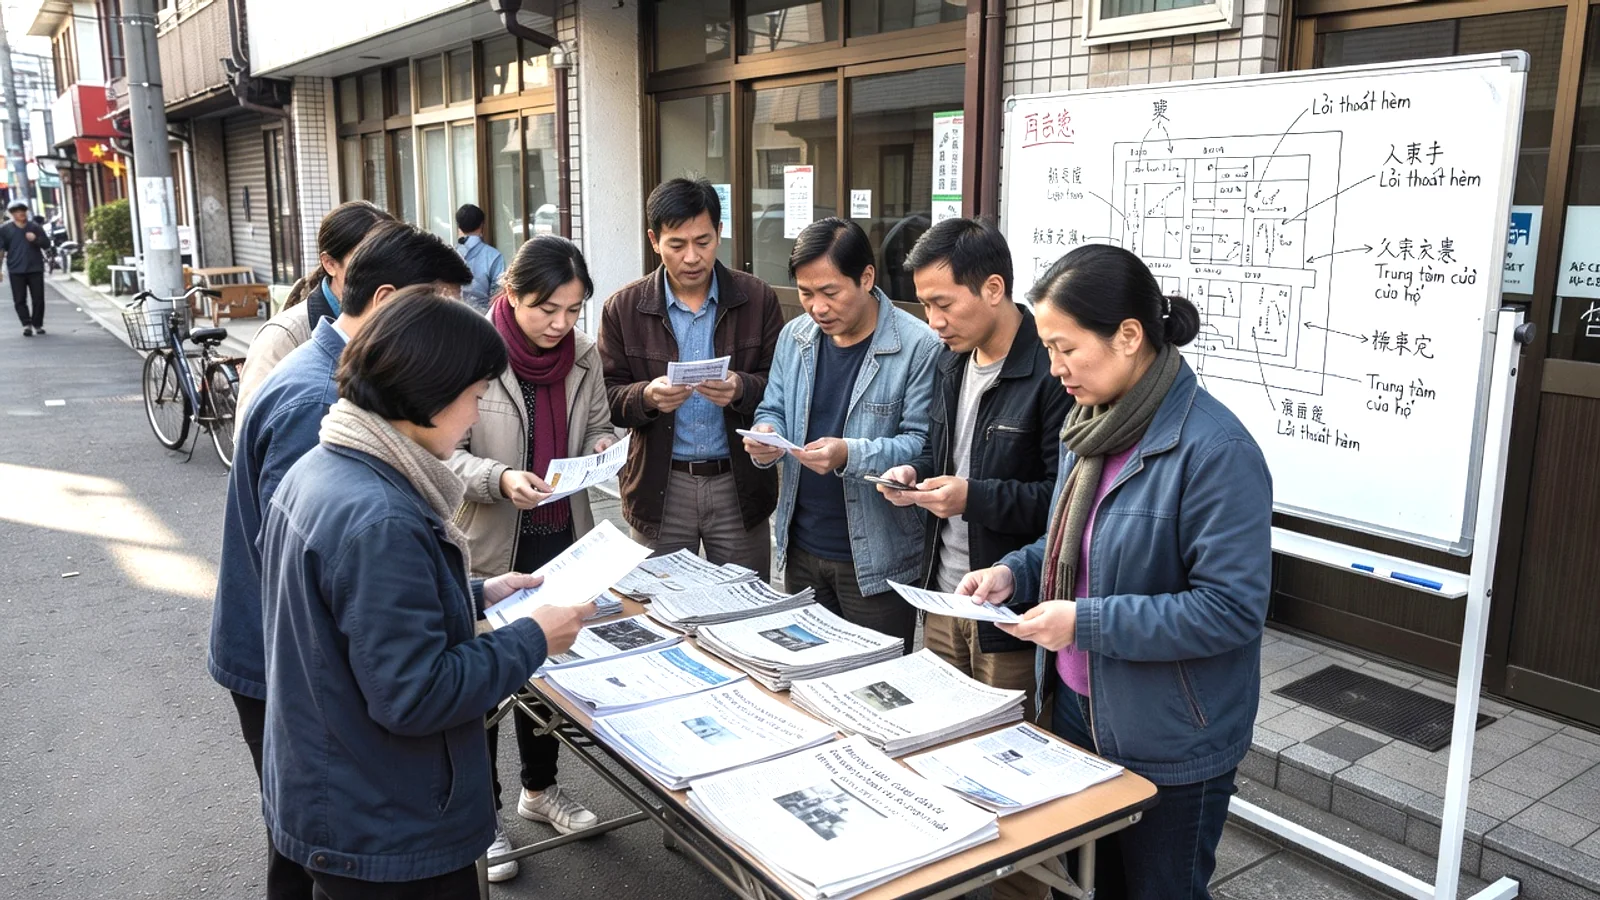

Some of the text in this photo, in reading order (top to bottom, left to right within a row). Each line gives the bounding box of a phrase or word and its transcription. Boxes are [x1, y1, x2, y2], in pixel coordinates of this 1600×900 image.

[1381, 90, 1411, 110] hèm
[1449, 167, 1481, 187] hèm
[1374, 262, 1413, 287] Trung
[1366, 373, 1404, 401] Trung
